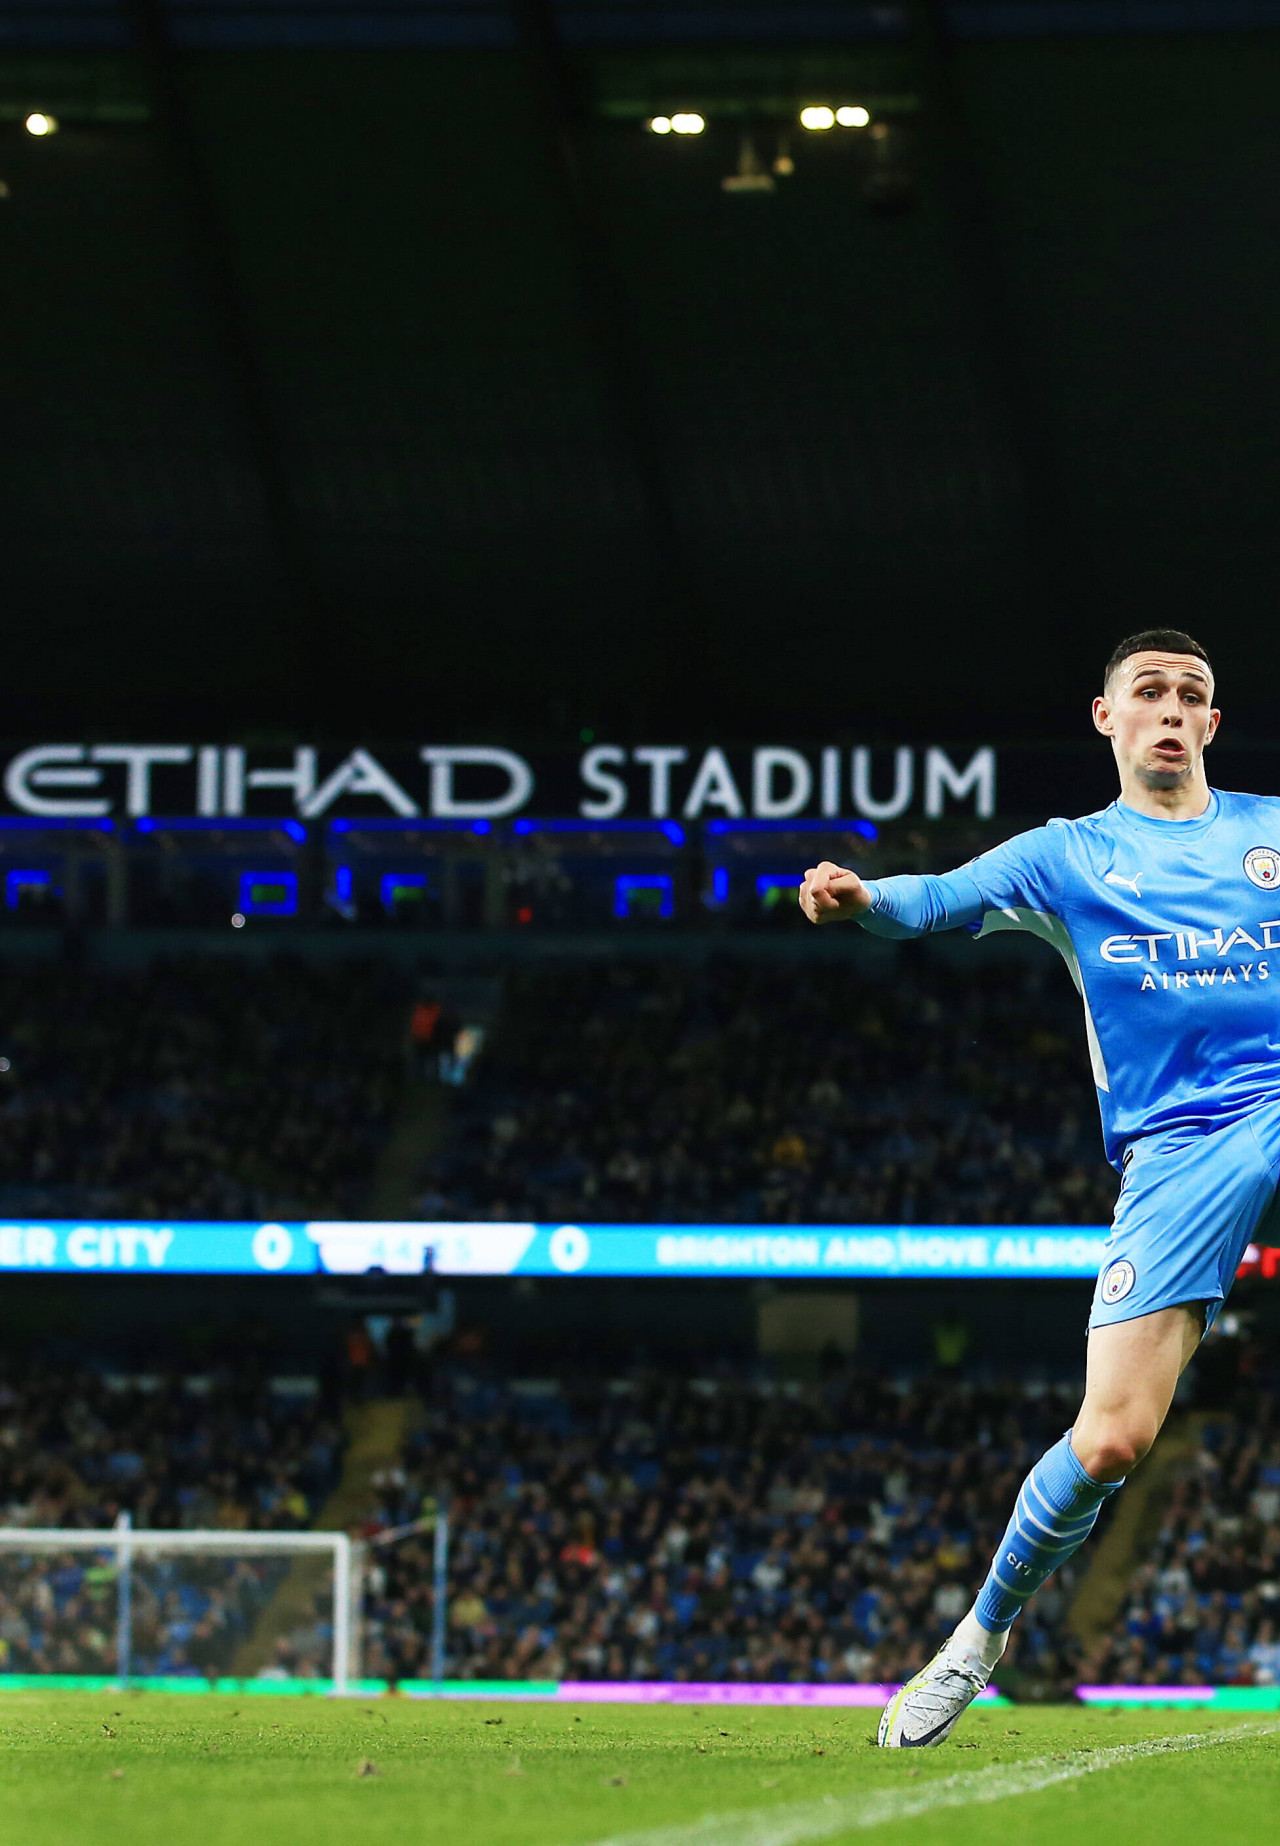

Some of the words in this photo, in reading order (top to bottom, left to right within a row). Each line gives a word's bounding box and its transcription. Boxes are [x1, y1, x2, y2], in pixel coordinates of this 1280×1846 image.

[4, 744, 534, 818] ETIHAD
[580, 745, 997, 819] STADIUM
[1140, 960, 1271, 991] AIRWAYS
[66, 1227, 174, 1268] CITY
[656, 1235, 819, 1267] BRIGHTON
[823, 1236, 896, 1267] AND
[900, 1235, 988, 1268] HOVE
